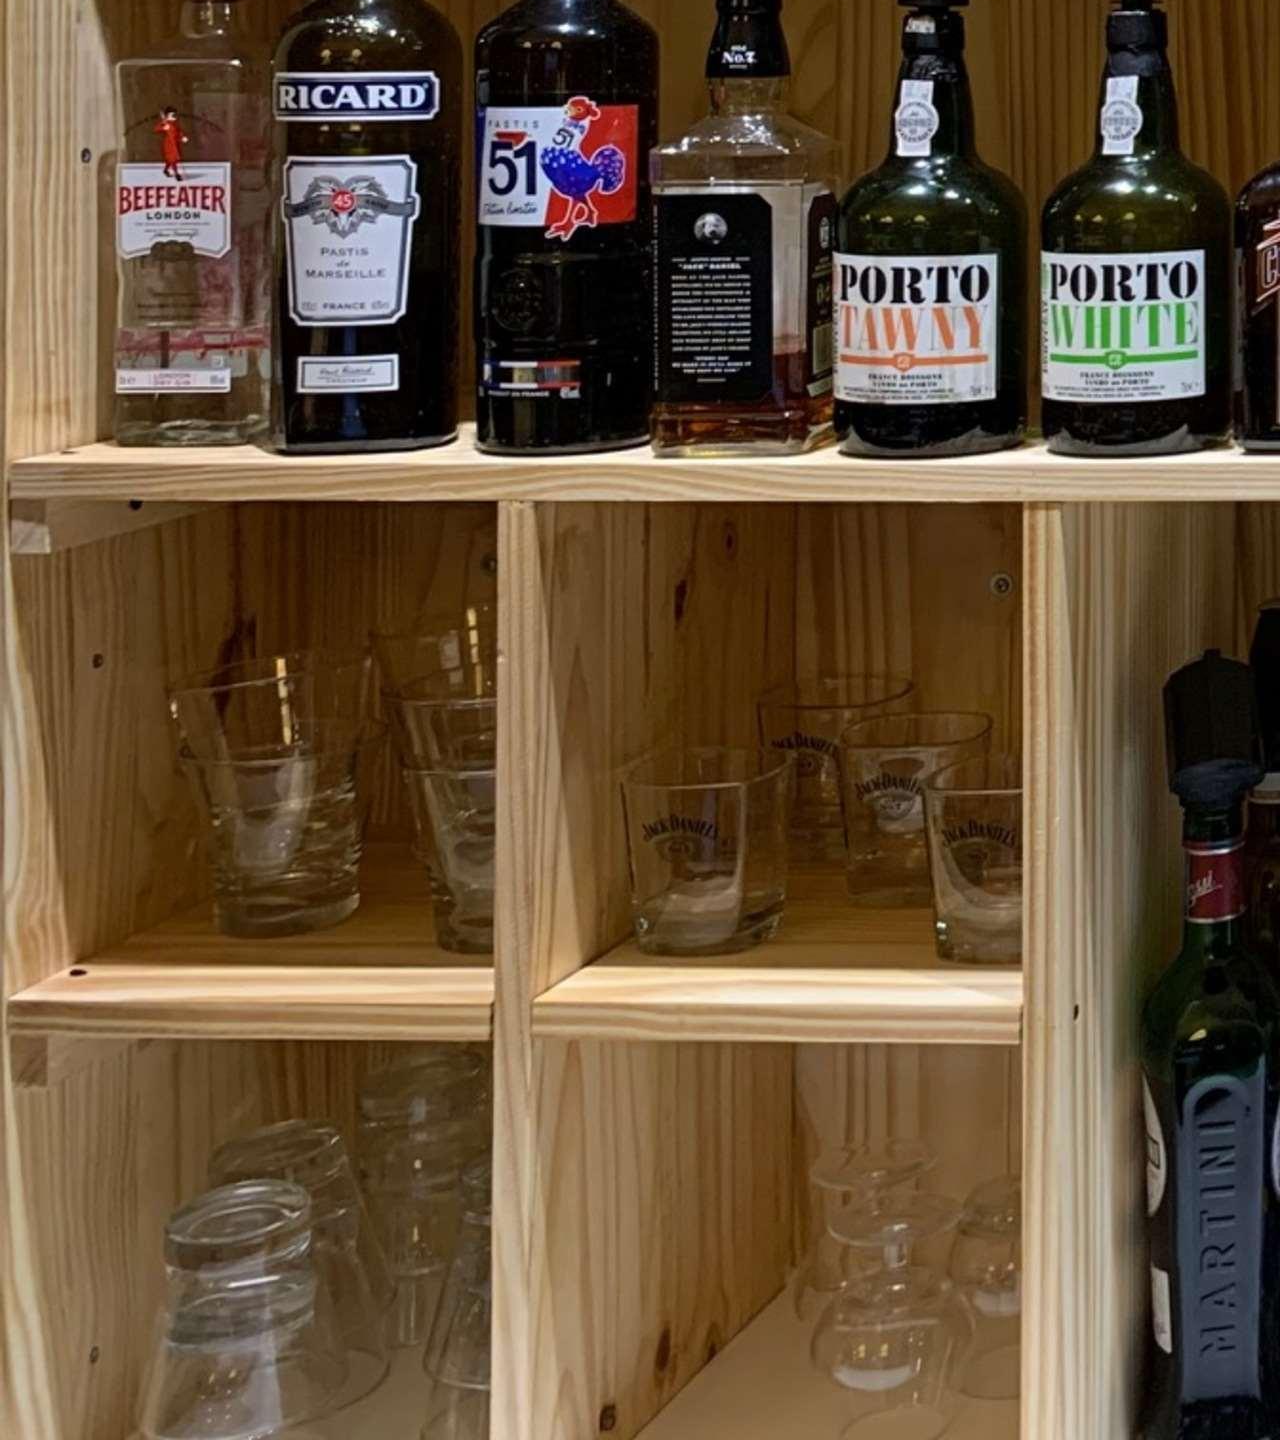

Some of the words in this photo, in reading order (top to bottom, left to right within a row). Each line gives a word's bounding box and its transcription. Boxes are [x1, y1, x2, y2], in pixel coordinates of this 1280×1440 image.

[278, 84, 430, 110] RICARD
[552, 127, 575, 148] 51
[488, 135, 537, 197] 51
[118, 185, 227, 216] BEEFEATER
[333, 193, 352, 208] 45
[145, 211, 202, 220] LONDON
[320, 247, 370, 257] PASTIS
[305, 268, 388, 279] MARSEILLE
[840, 263, 990, 304] PORTO
[1050, 260, 1199, 303] PORTO
[322, 302, 367, 311] FRANCE
[840, 304, 989, 355] TAWNY
[1050, 301, 1199, 350] WHITE
[641, 816, 671, 842] JACK
[1200, 1117, 1237, 1358] MARTINI
